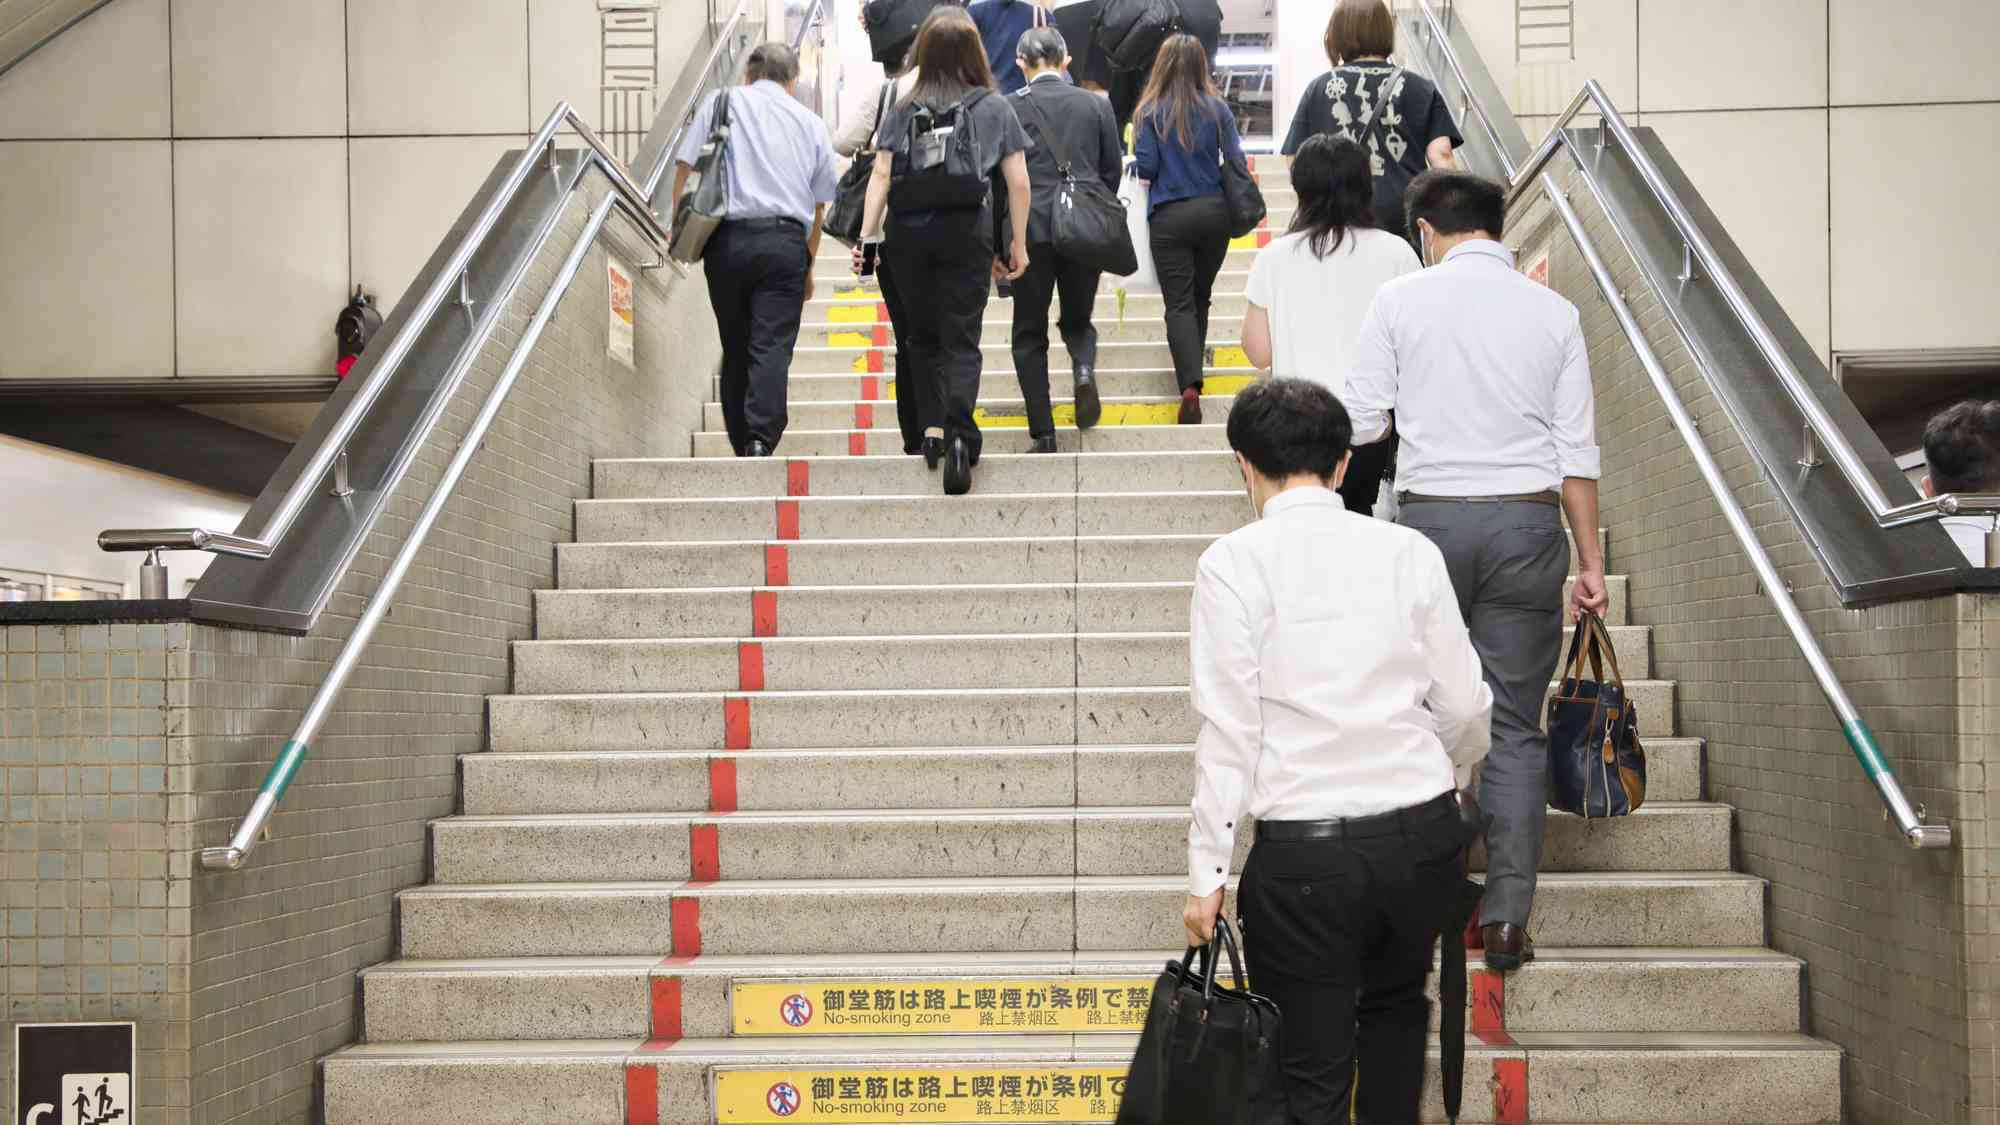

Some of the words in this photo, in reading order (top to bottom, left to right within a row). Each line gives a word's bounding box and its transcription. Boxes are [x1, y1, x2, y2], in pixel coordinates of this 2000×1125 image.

[824, 1011, 911, 1027] No-smoking
[915, 1013, 951, 1025] zone
[979, 1011, 1059, 1026] 路上禁烟区
[813, 1101, 904, 1116] No-smoking
[909, 1102, 946, 1113] zone
[976, 1099, 1060, 1115] 路上禁烟区
